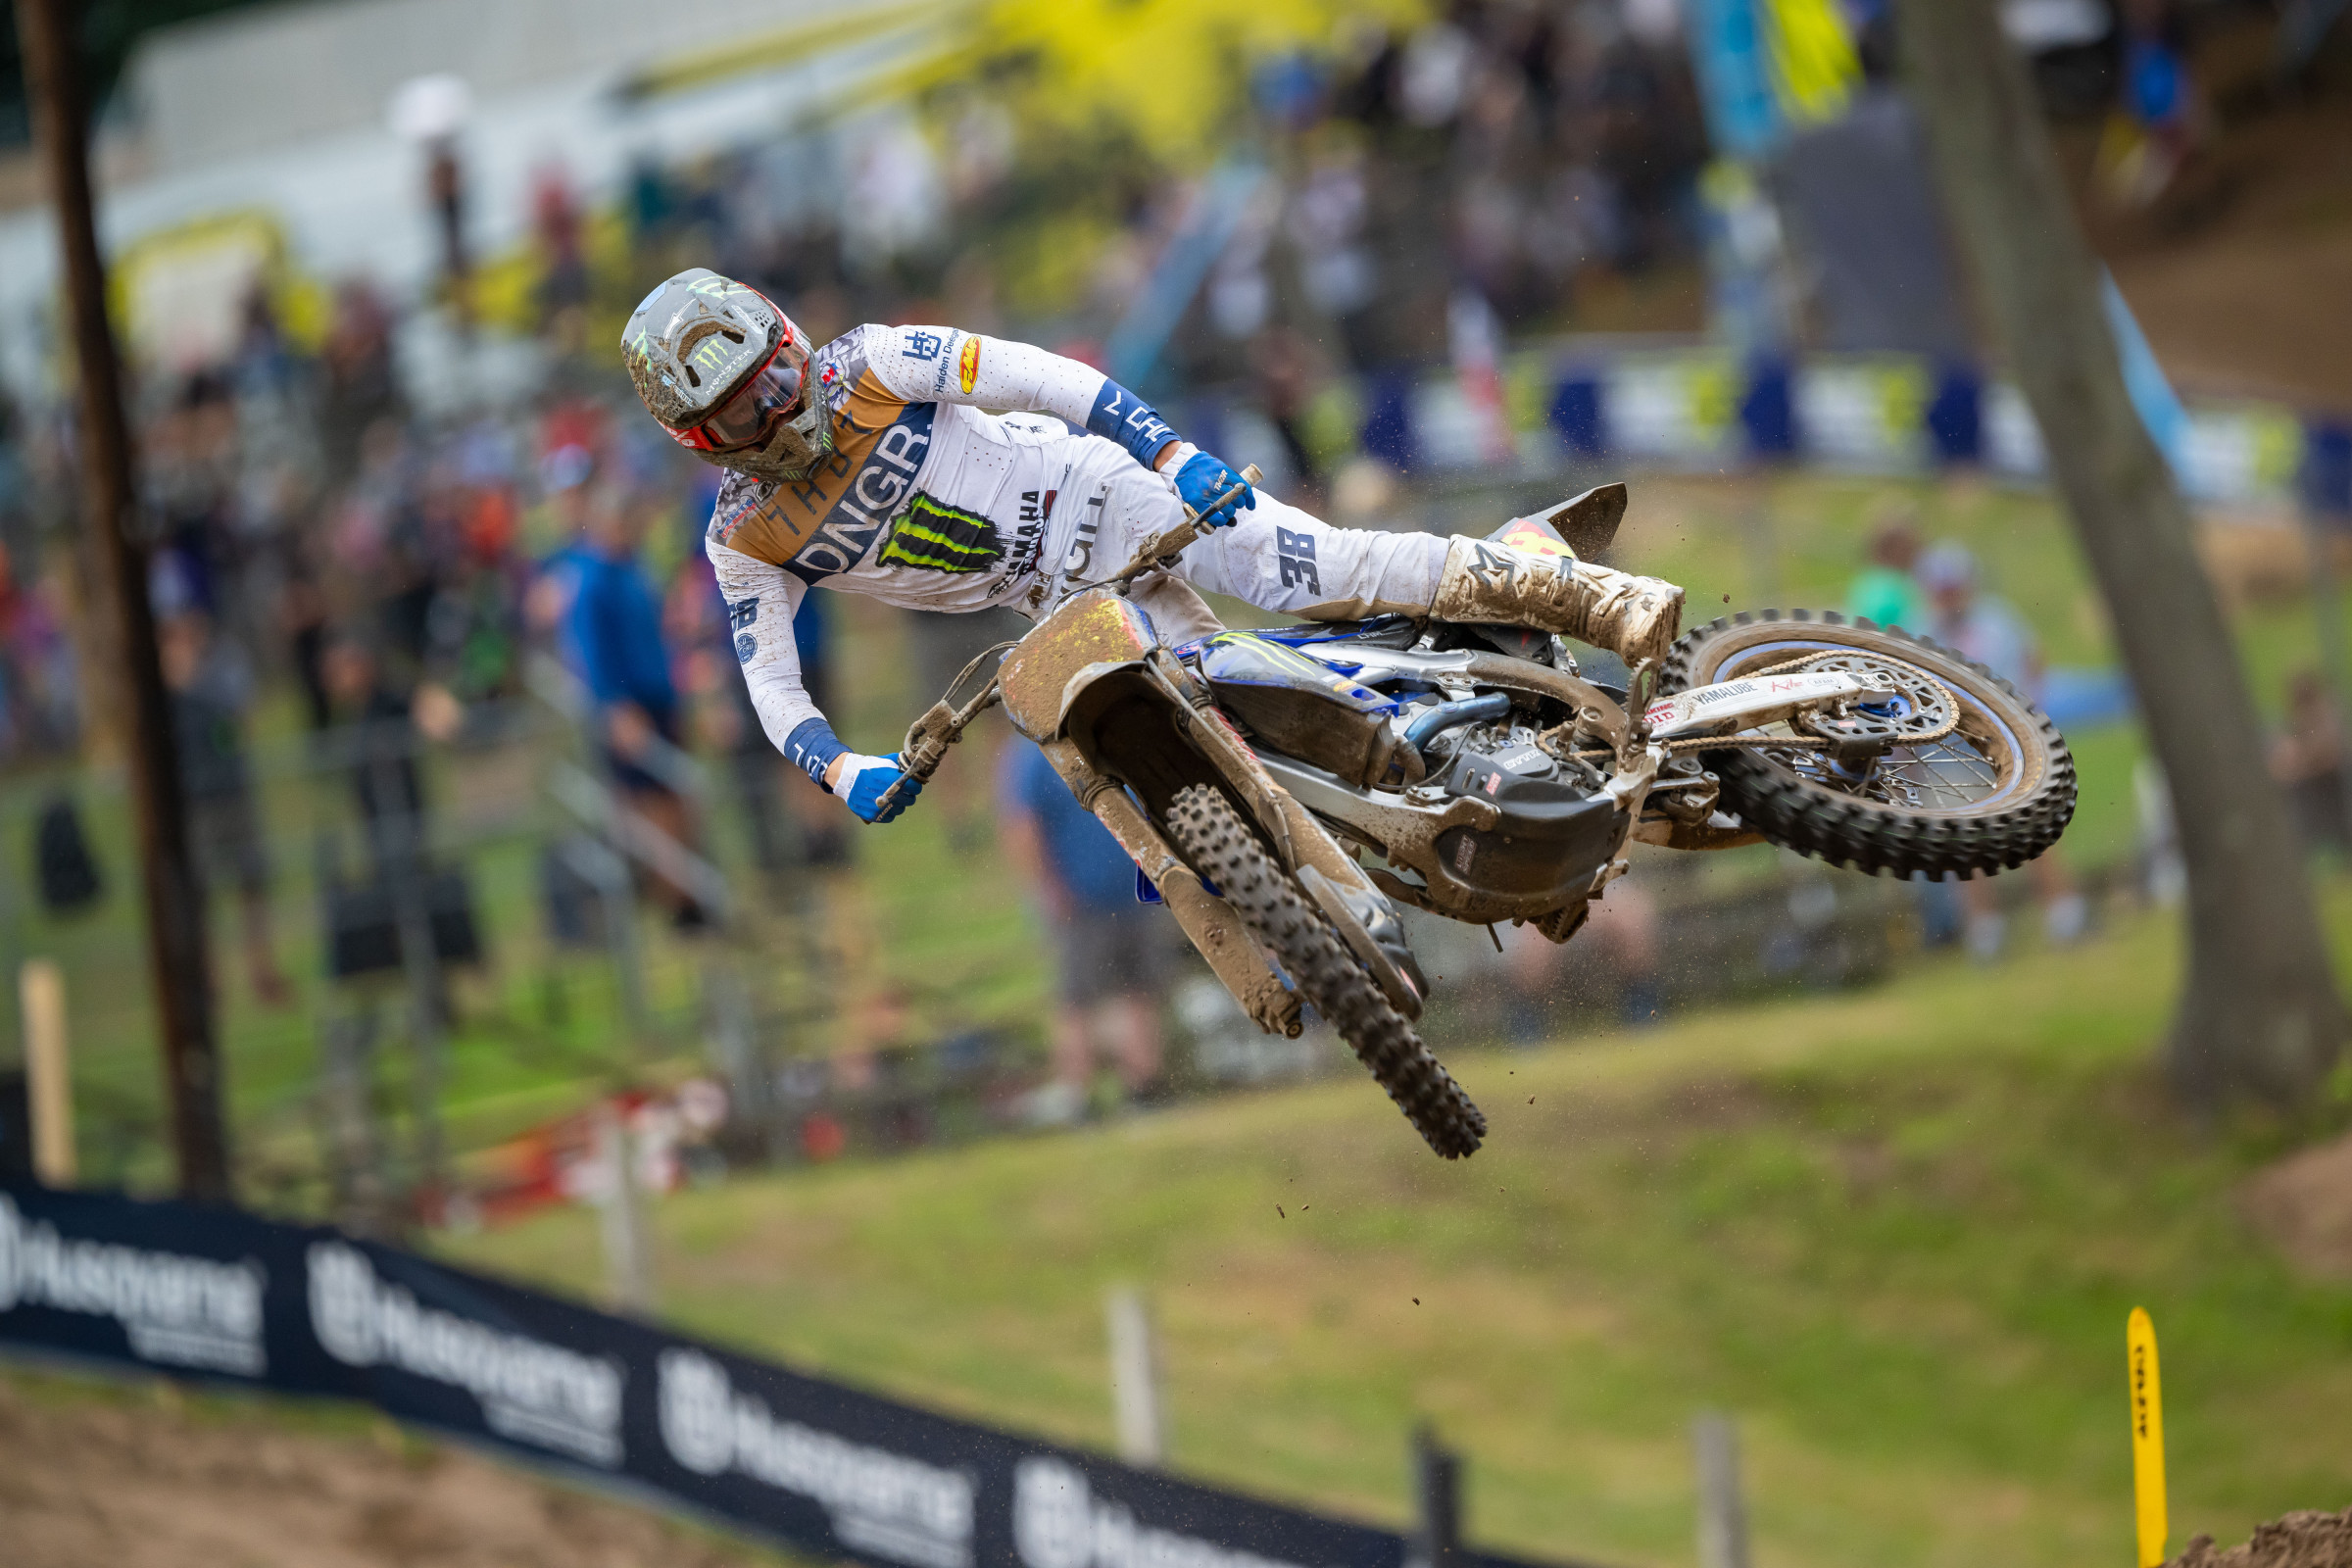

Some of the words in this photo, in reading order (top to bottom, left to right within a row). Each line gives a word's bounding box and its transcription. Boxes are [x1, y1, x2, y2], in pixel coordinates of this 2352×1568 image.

[705, 348, 754, 396] MONSTER
[934, 356, 951, 393] Haiden
[961, 335, 981, 394] FMF
[1213, 468, 1228, 492] THOR
[1005, 490, 1040, 576] AMAHA
[1276, 524, 1322, 598] 38
[1692, 681, 1758, 706] YAMALUBE
[1503, 749, 1542, 770] GYTR
[875, 803, 894, 822] THOR
